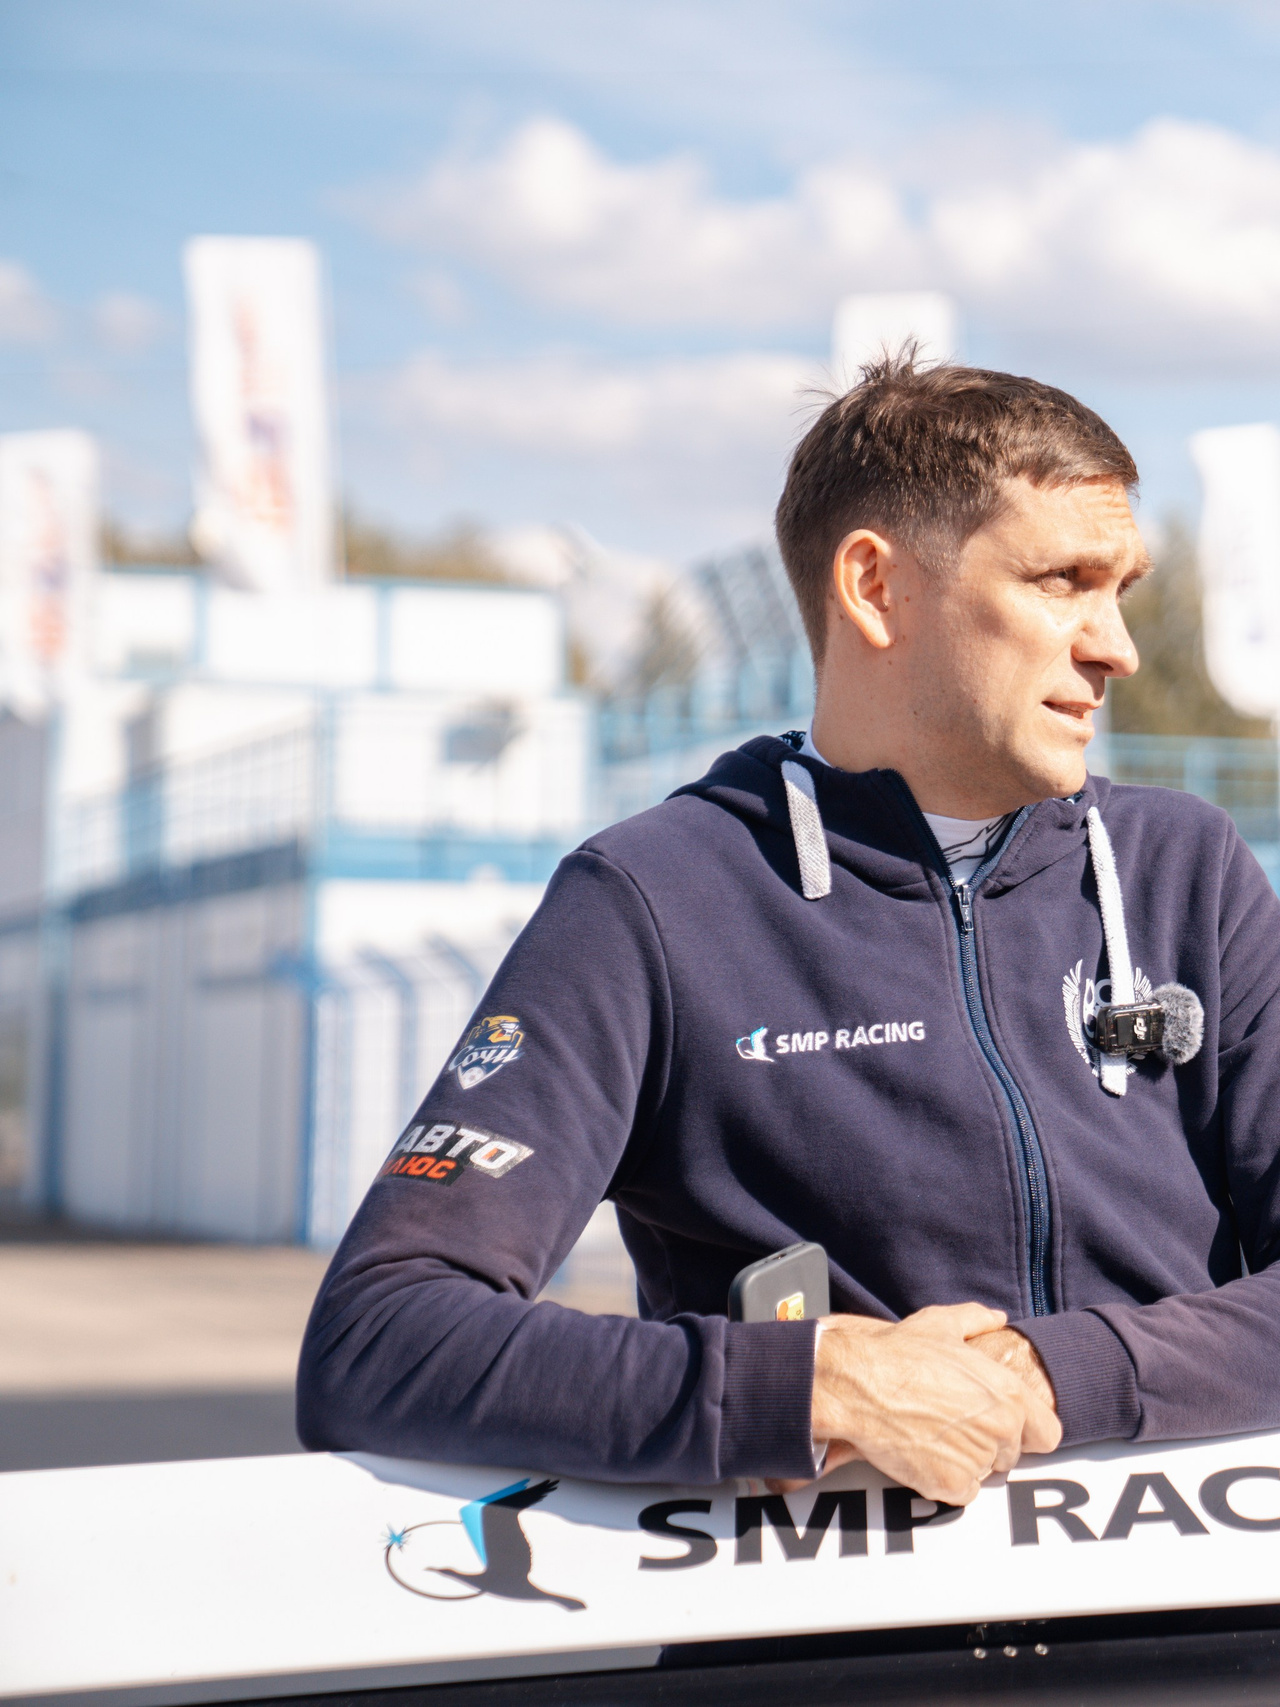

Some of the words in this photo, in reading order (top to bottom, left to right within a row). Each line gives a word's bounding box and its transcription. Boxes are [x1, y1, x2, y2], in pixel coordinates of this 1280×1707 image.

[776, 1031, 829, 1054] SMP
[834, 1021, 925, 1049] RACING
[396, 1124, 518, 1170] АВТО
[382, 1155, 457, 1179] ЛЮС
[637, 1488, 966, 1571] SMP
